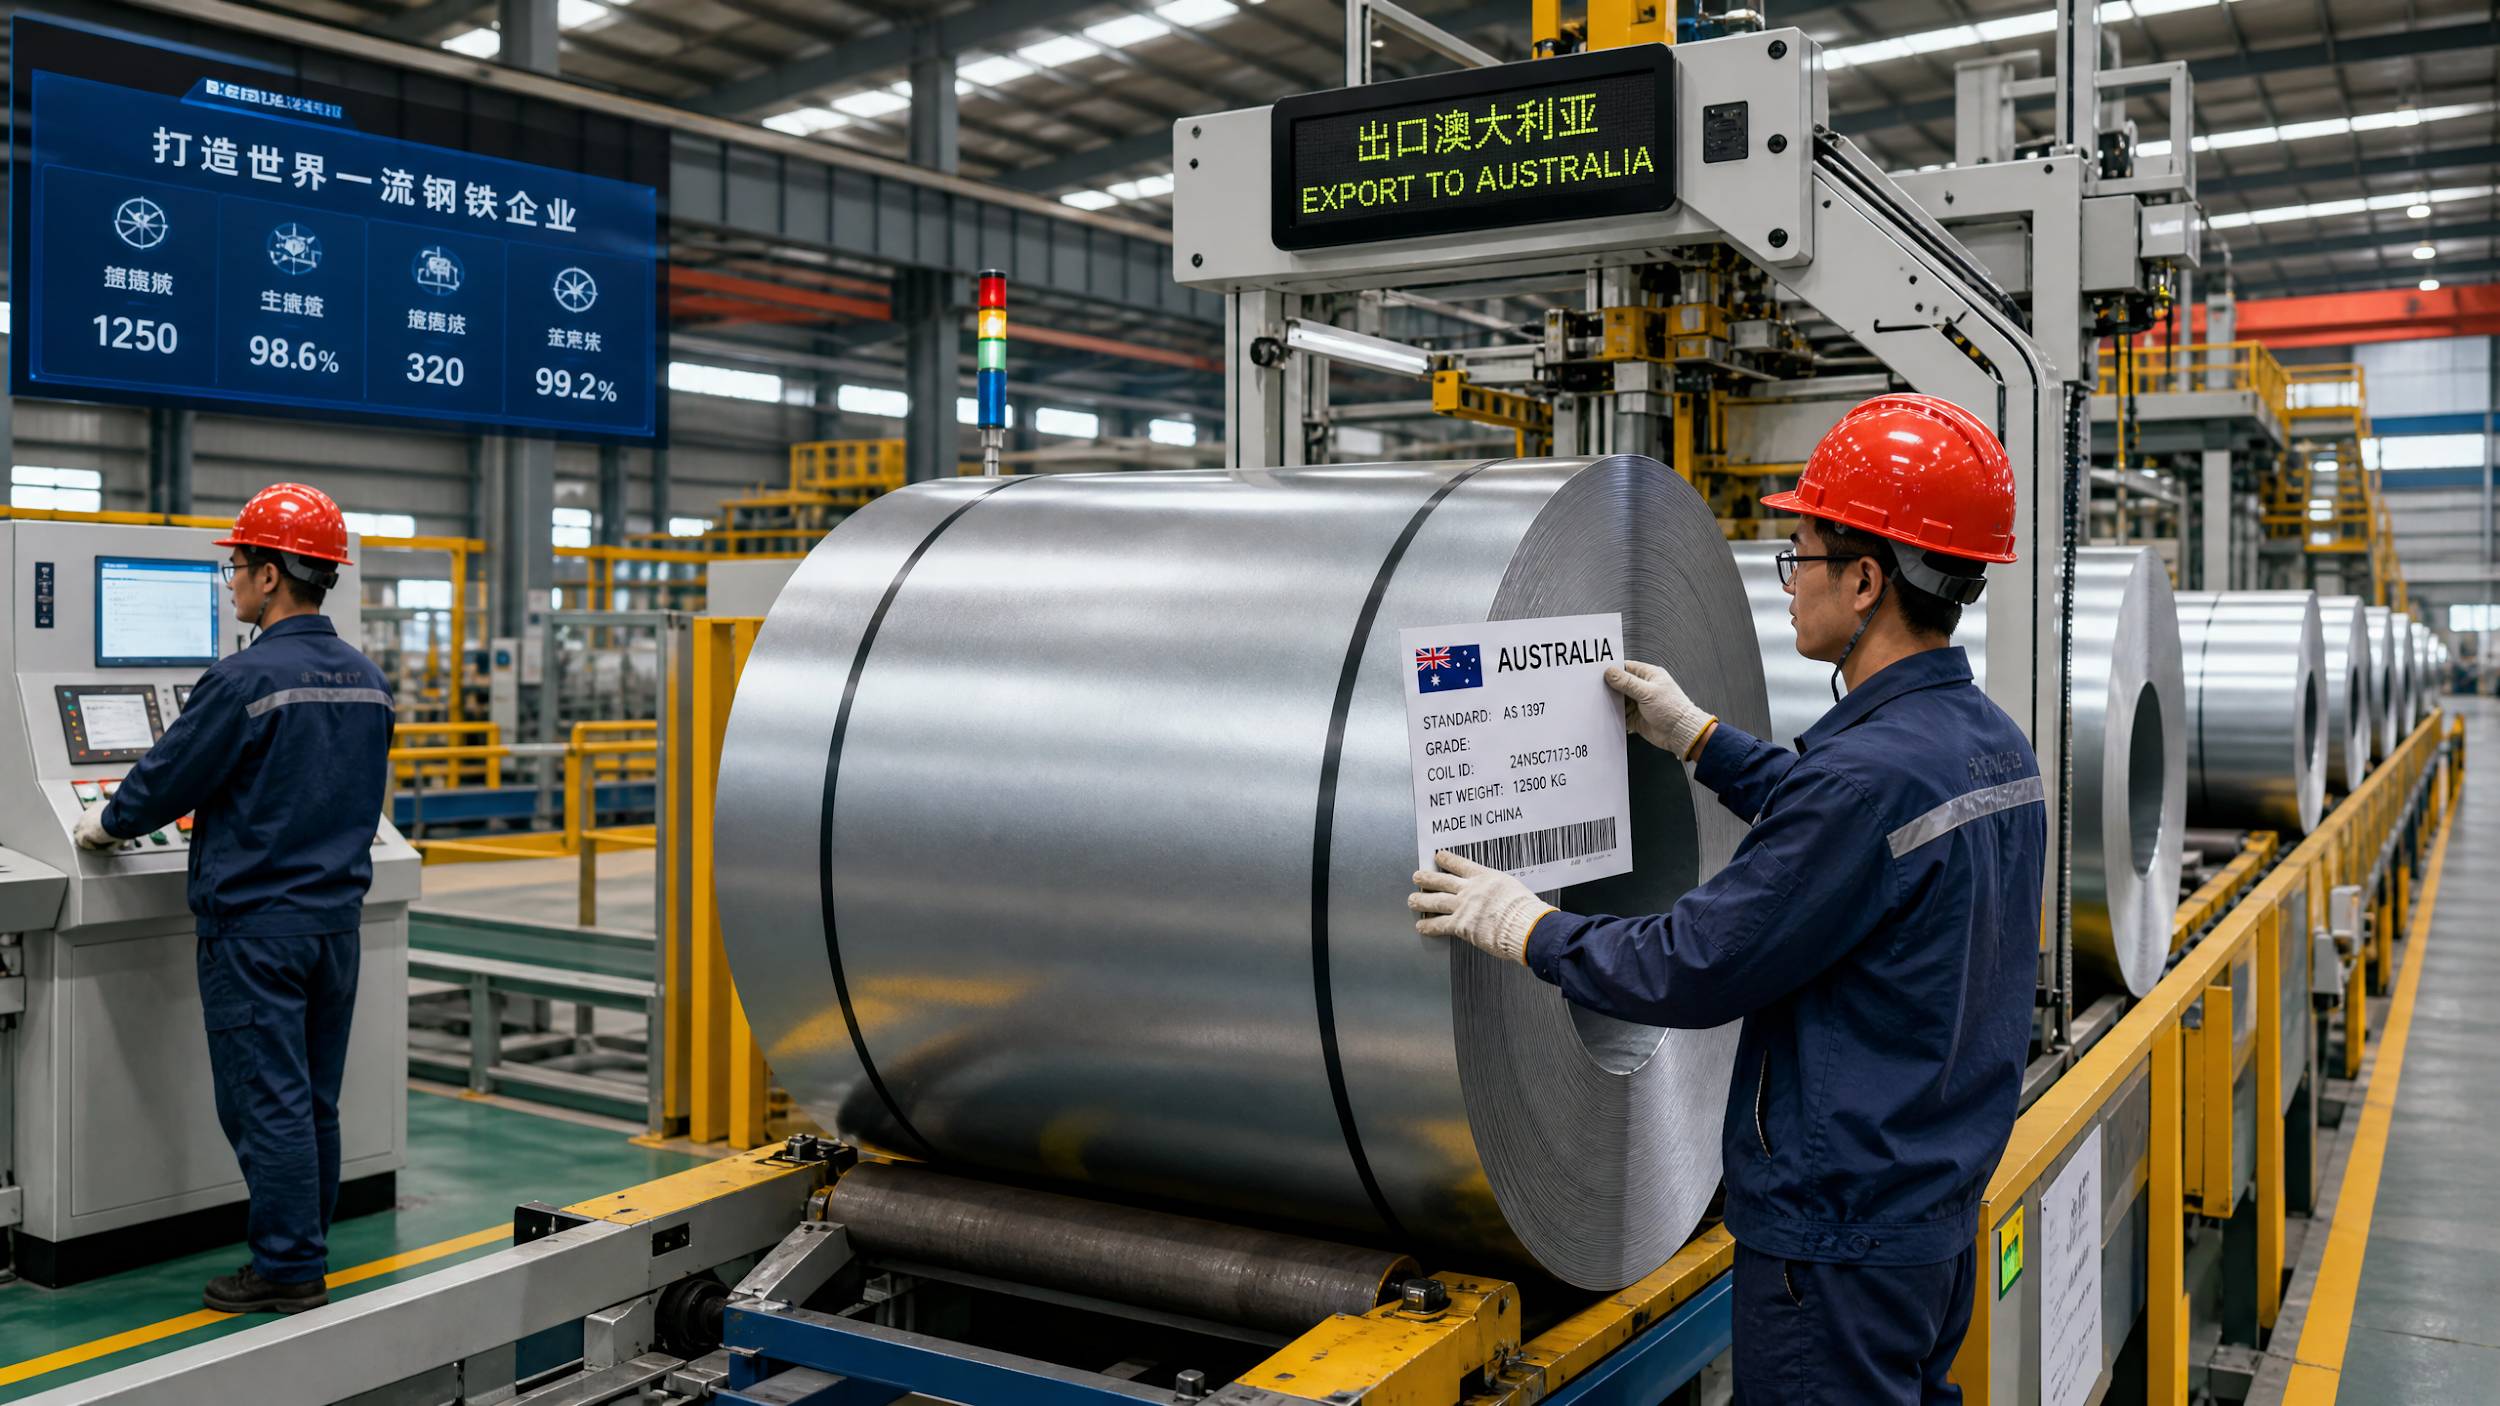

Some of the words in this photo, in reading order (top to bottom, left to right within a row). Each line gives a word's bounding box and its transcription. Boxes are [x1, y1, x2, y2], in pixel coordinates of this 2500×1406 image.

[1357, 92, 1600, 164] 出口澳大利亚
[152, 126, 578, 234] 打造世界一流钢铁企业
[1301, 174, 1416, 214] EXPORT
[1425, 168, 1463, 199] TO
[1475, 145, 1655, 195] AUSTRALIA
[93, 314, 178, 354] 1250
[249, 335, 340, 374] 98.6%
[406, 352, 465, 387] 320
[535, 367, 618, 403] 99.2%
[1497, 637, 1614, 673] AUSTRALIA
[1423, 709, 1492, 730] STANDARD:
[1503, 706, 1518, 720] AS
[1521, 702, 1546, 718] 1397
[1426, 737, 1471, 756] GRADE:
[1427, 766, 1455, 782] COIL
[1458, 763, 1475, 777] ID:
[1430, 791, 1452, 808] NET
[1456, 783, 1504, 804] WEIGHT:
[1513, 776, 1547, 794] 12500
[1550, 773, 1567, 788] KG
[1432, 817, 1467, 834] MADE
[1470, 815, 1483, 827] IN
[1486, 806, 1523, 824] CHINA
